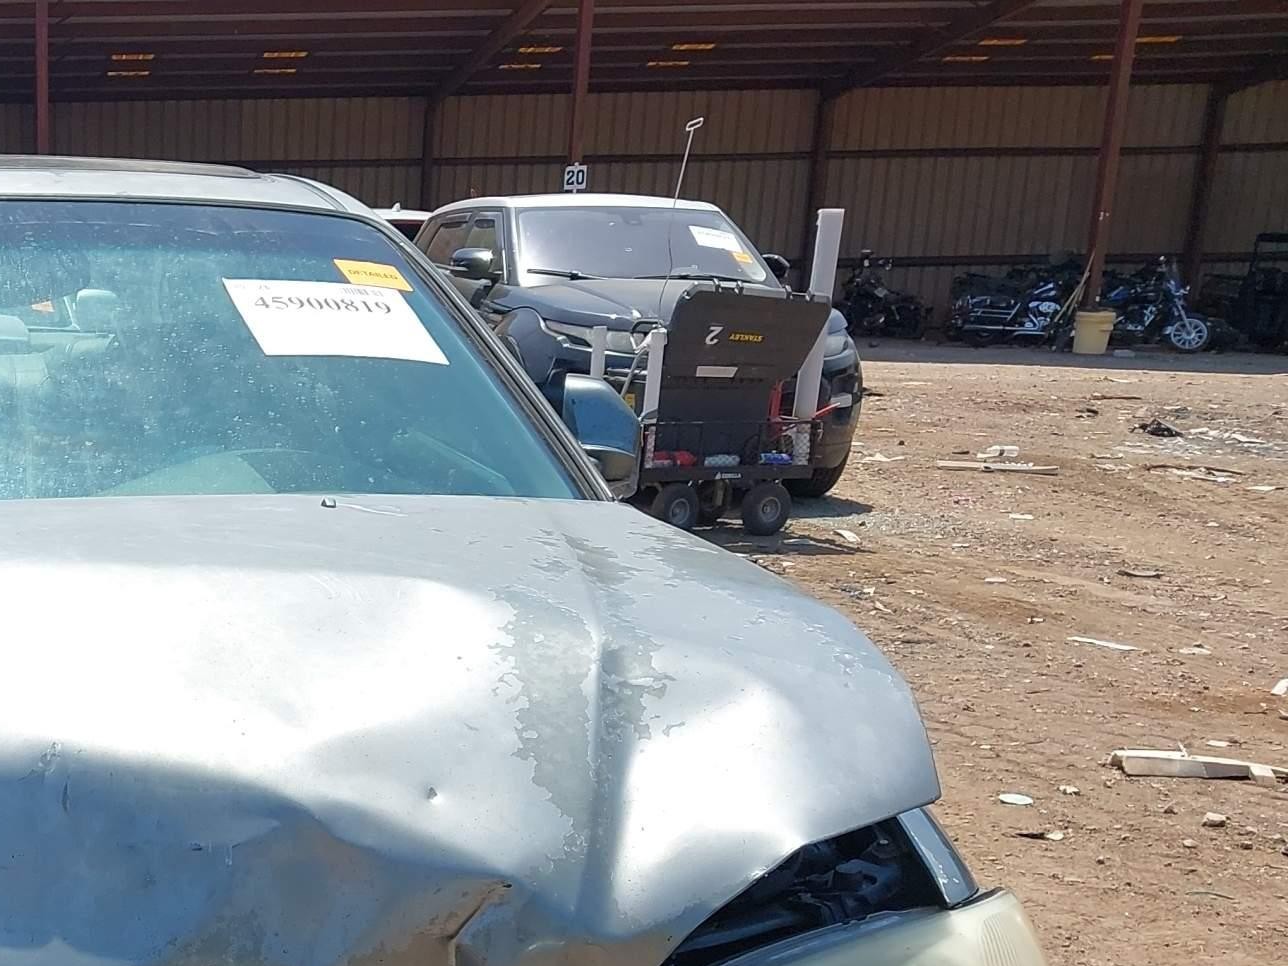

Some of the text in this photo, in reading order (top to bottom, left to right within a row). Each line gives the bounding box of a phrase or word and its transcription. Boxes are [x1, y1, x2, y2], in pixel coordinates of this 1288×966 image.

[566, 169, 585, 185] 20
[254, 296, 392, 314] 45900819
[705, 326, 724, 345] 2
[729, 333, 764, 342] STANLEY
